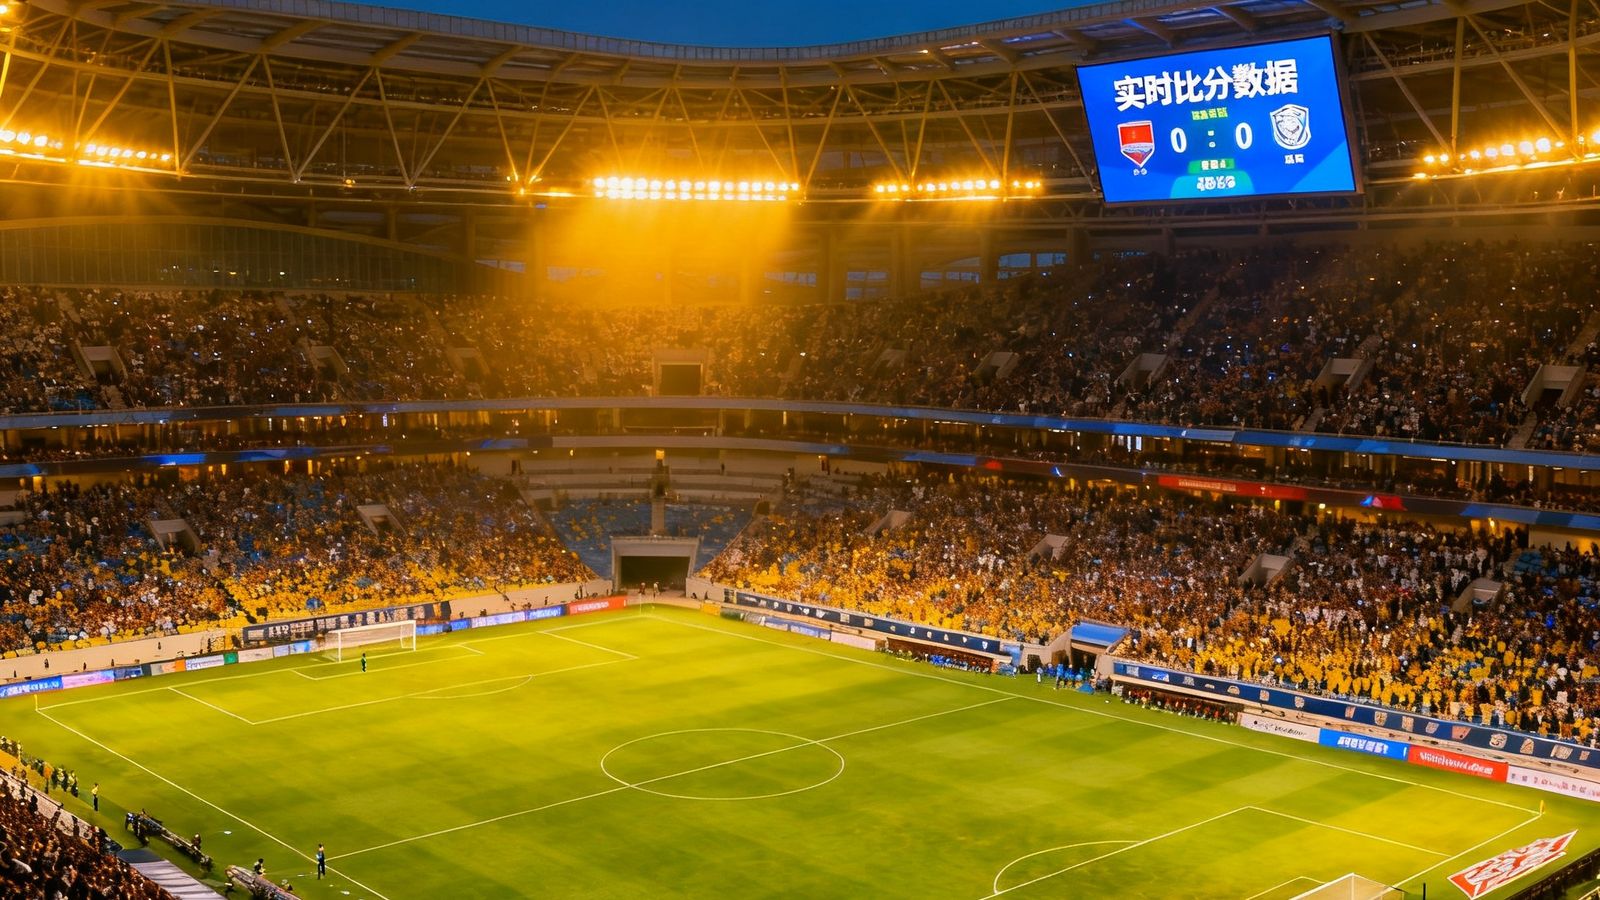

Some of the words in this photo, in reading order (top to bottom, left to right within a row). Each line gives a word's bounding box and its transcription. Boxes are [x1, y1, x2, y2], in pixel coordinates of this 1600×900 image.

[1114, 59, 1299, 112] 实时比分数据
[1170, 127, 1187, 153] 0
[1235, 122, 1253, 150] 0
